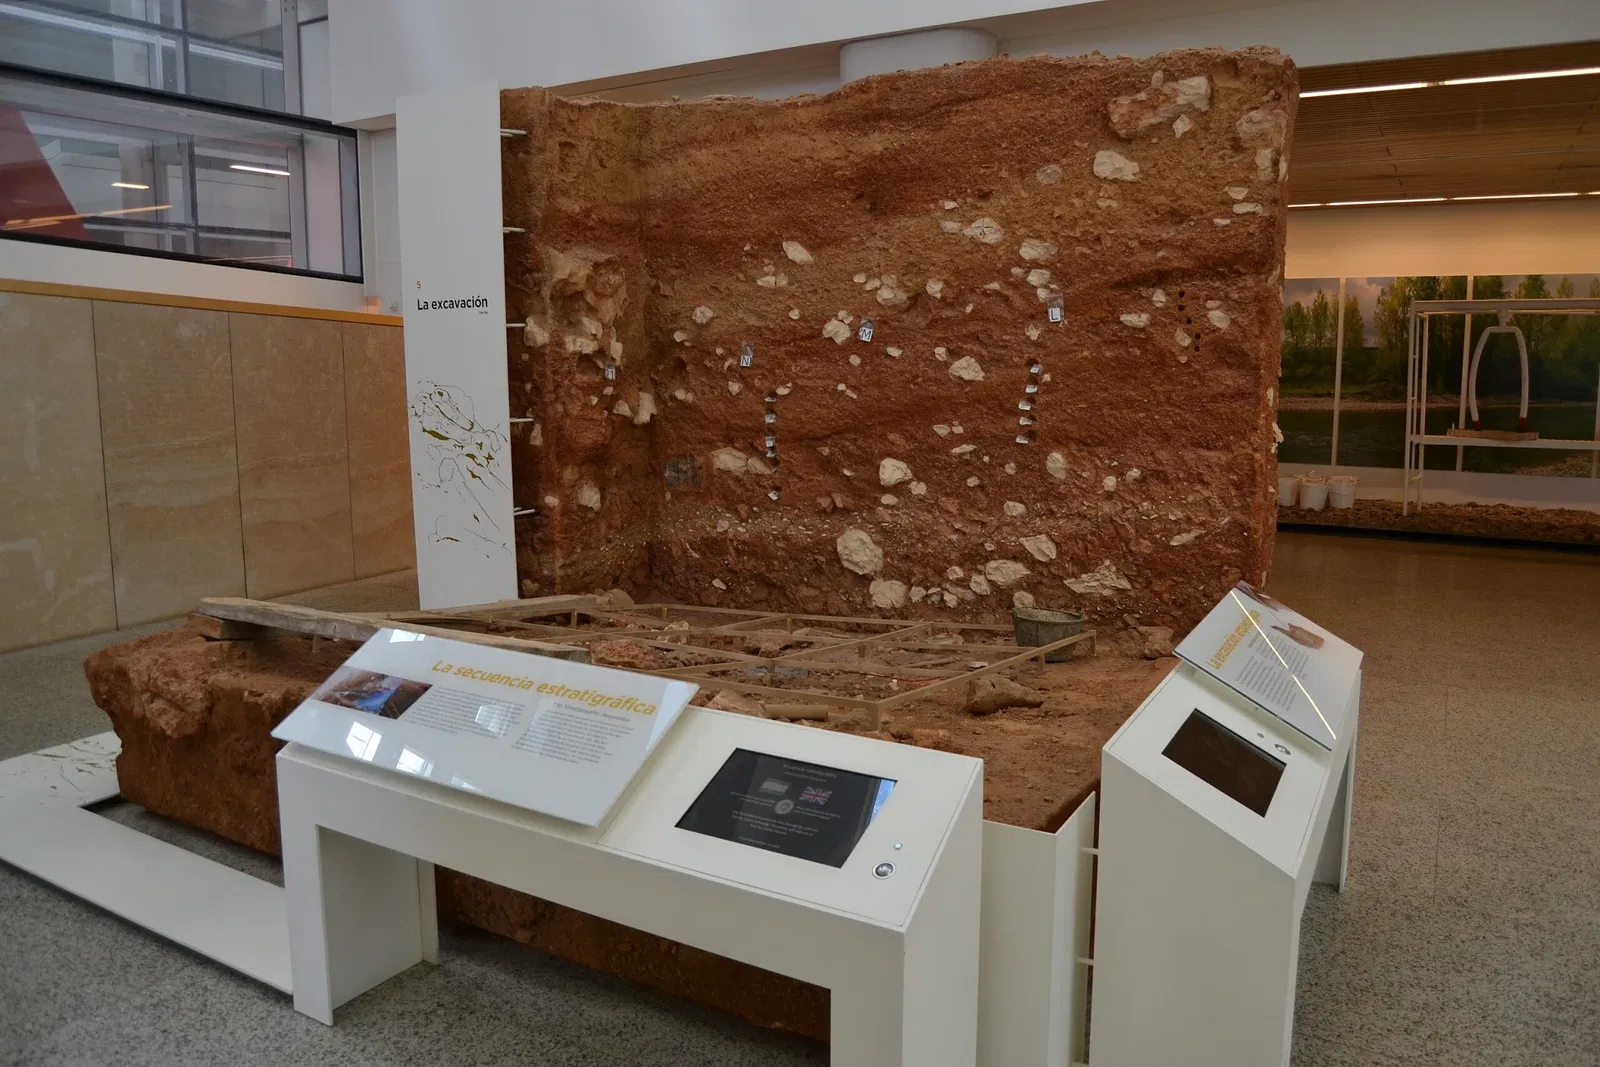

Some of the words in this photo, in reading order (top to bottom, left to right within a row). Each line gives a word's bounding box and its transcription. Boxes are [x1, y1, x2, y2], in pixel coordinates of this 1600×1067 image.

[417, 298, 429, 311] La
[431, 294, 488, 310] excavación
[1050, 309, 1059, 320] L
[860, 328, 872, 341] M
[432, 659, 454, 674] La
[453, 667, 534, 690] secuencia
[536, 682, 658, 716] estratigráfica
